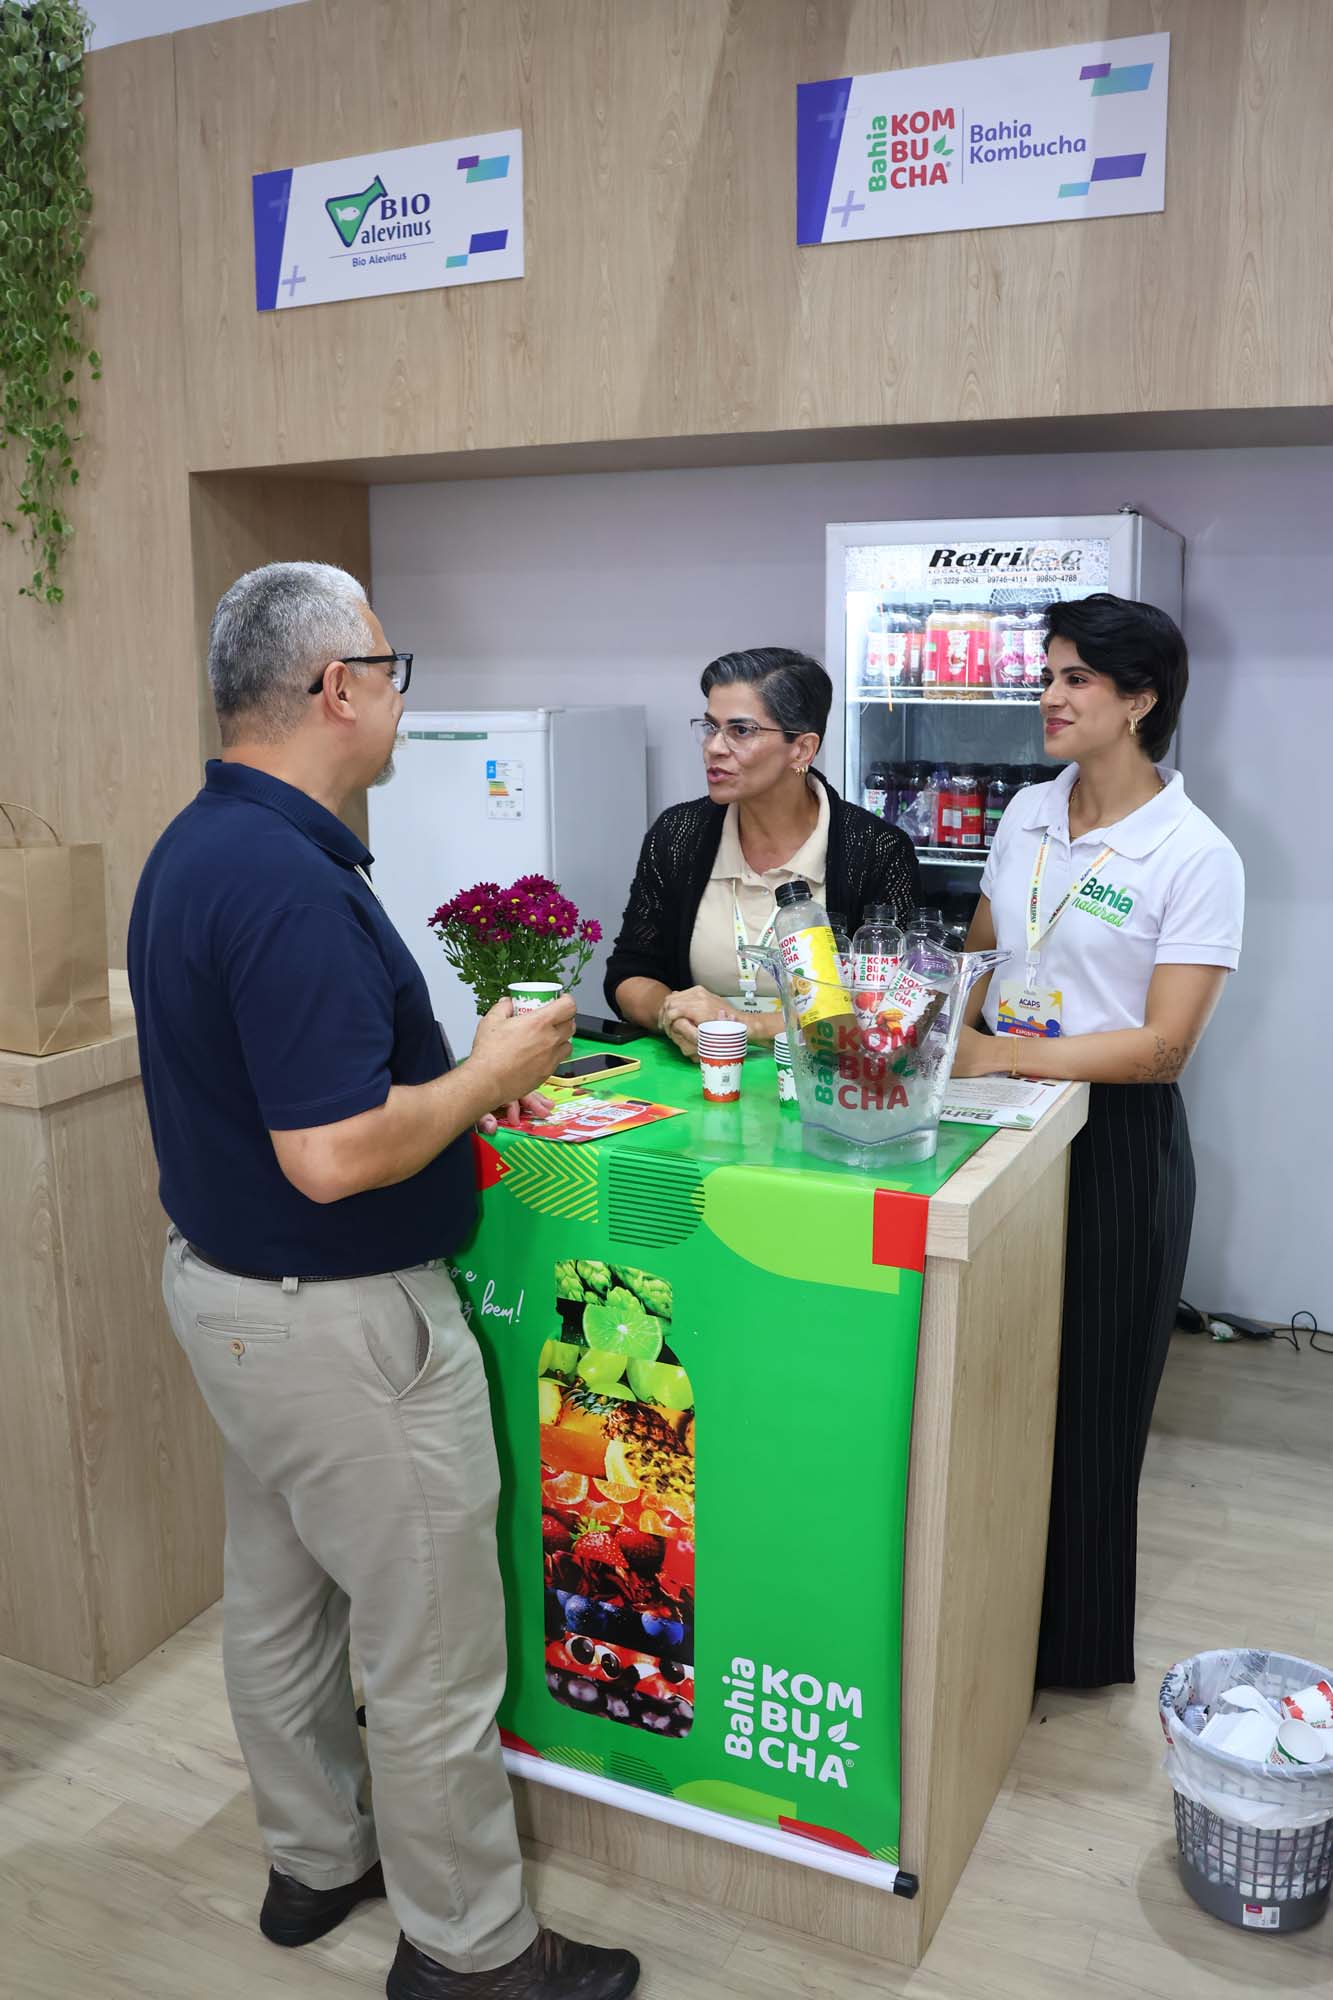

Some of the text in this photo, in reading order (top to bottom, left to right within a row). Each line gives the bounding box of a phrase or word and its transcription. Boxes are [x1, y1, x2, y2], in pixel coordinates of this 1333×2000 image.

[891, 107, 955, 137] KOM
[970, 119, 1032, 144] Bahia
[866, 115, 888, 192] Bahia
[891, 138, 929, 163] BU
[970, 135, 1086, 164] Kombucha
[890, 162, 949, 190] CHA
[381, 193, 431, 221] BIO
[361, 220, 432, 244] alevinus
[352, 252, 407, 267] Bio Alevinus
[1080, 877, 1133, 915] Bahia
[894, 992, 913, 1008] CHA
[838, 1024, 918, 1053] KOM
[811, 1021, 834, 1106] Bahia
[838, 1055, 887, 1082] BU
[838, 1084, 910, 1111] CHA
[481, 1280, 524, 1325] bem!
[762, 1663, 863, 1719] KOM
[722, 1656, 756, 1760] Bahia
[761, 1700, 820, 1742] BU
